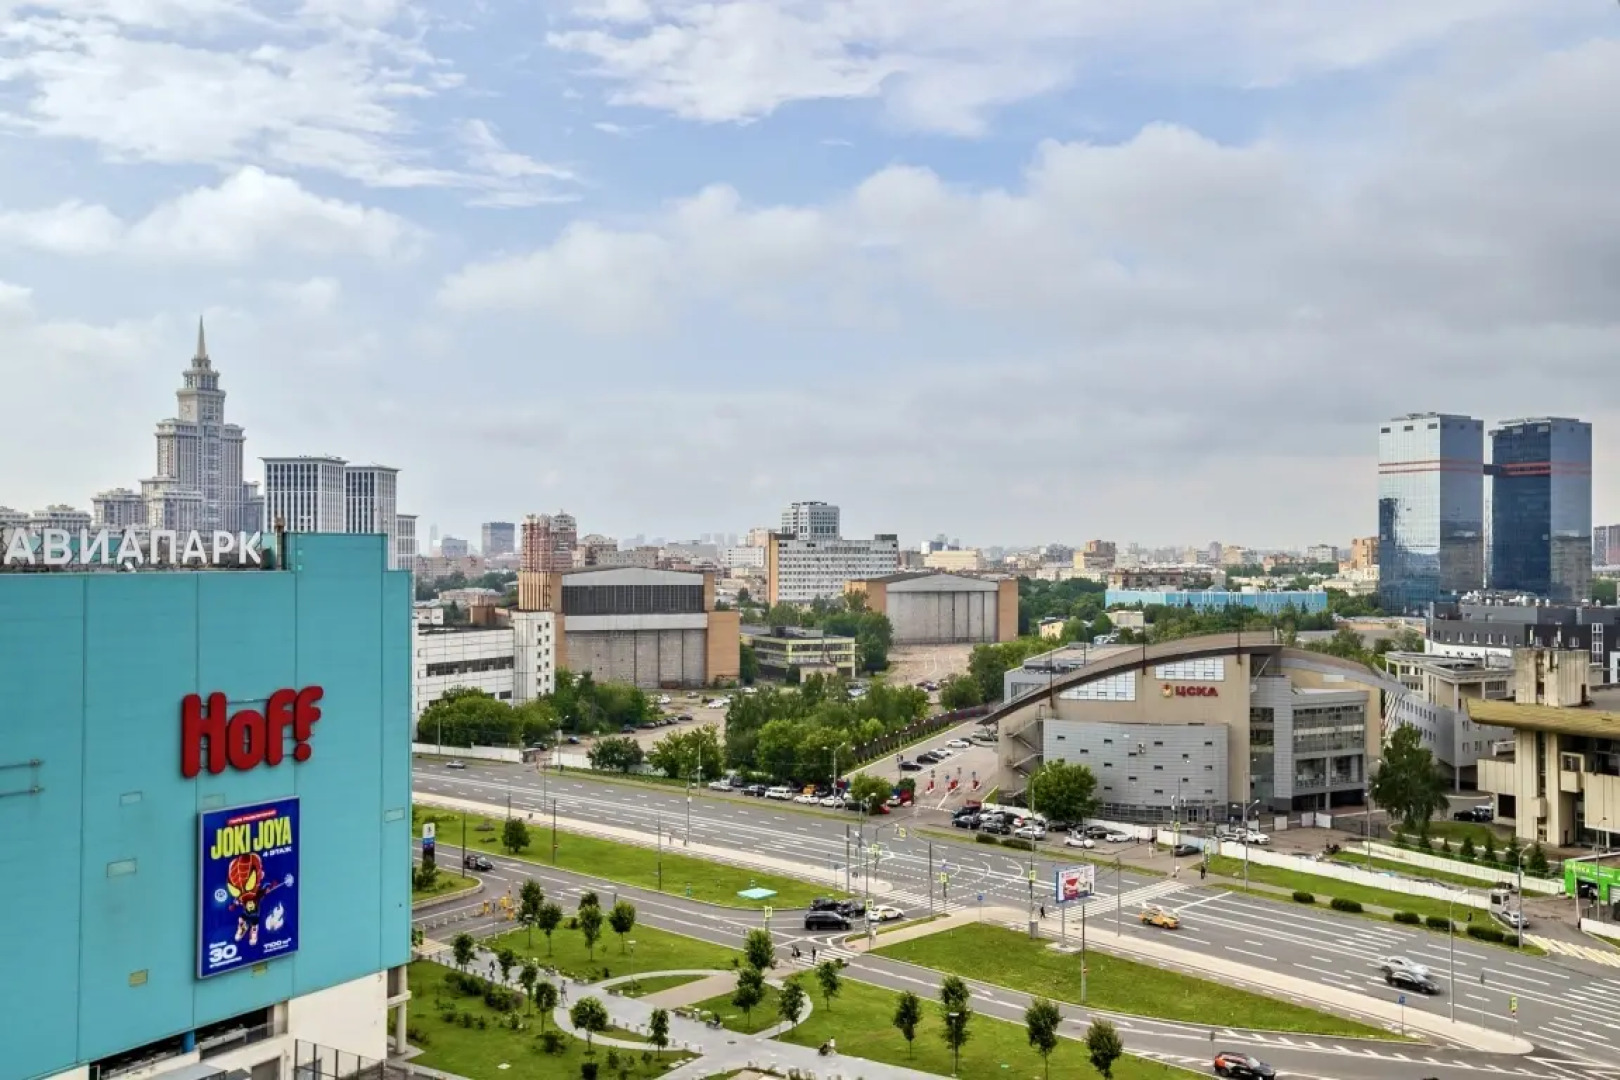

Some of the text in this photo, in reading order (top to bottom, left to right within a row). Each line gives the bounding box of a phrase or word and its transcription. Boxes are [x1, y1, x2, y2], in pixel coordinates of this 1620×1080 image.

[3, 528, 262, 565] АВИАПАРК
[1175, 685, 1219, 697] ЦСКА
[211, 823, 251, 859] JOKI
[253, 816, 292, 851] JOYA
[209, 945, 237, 962] 30
